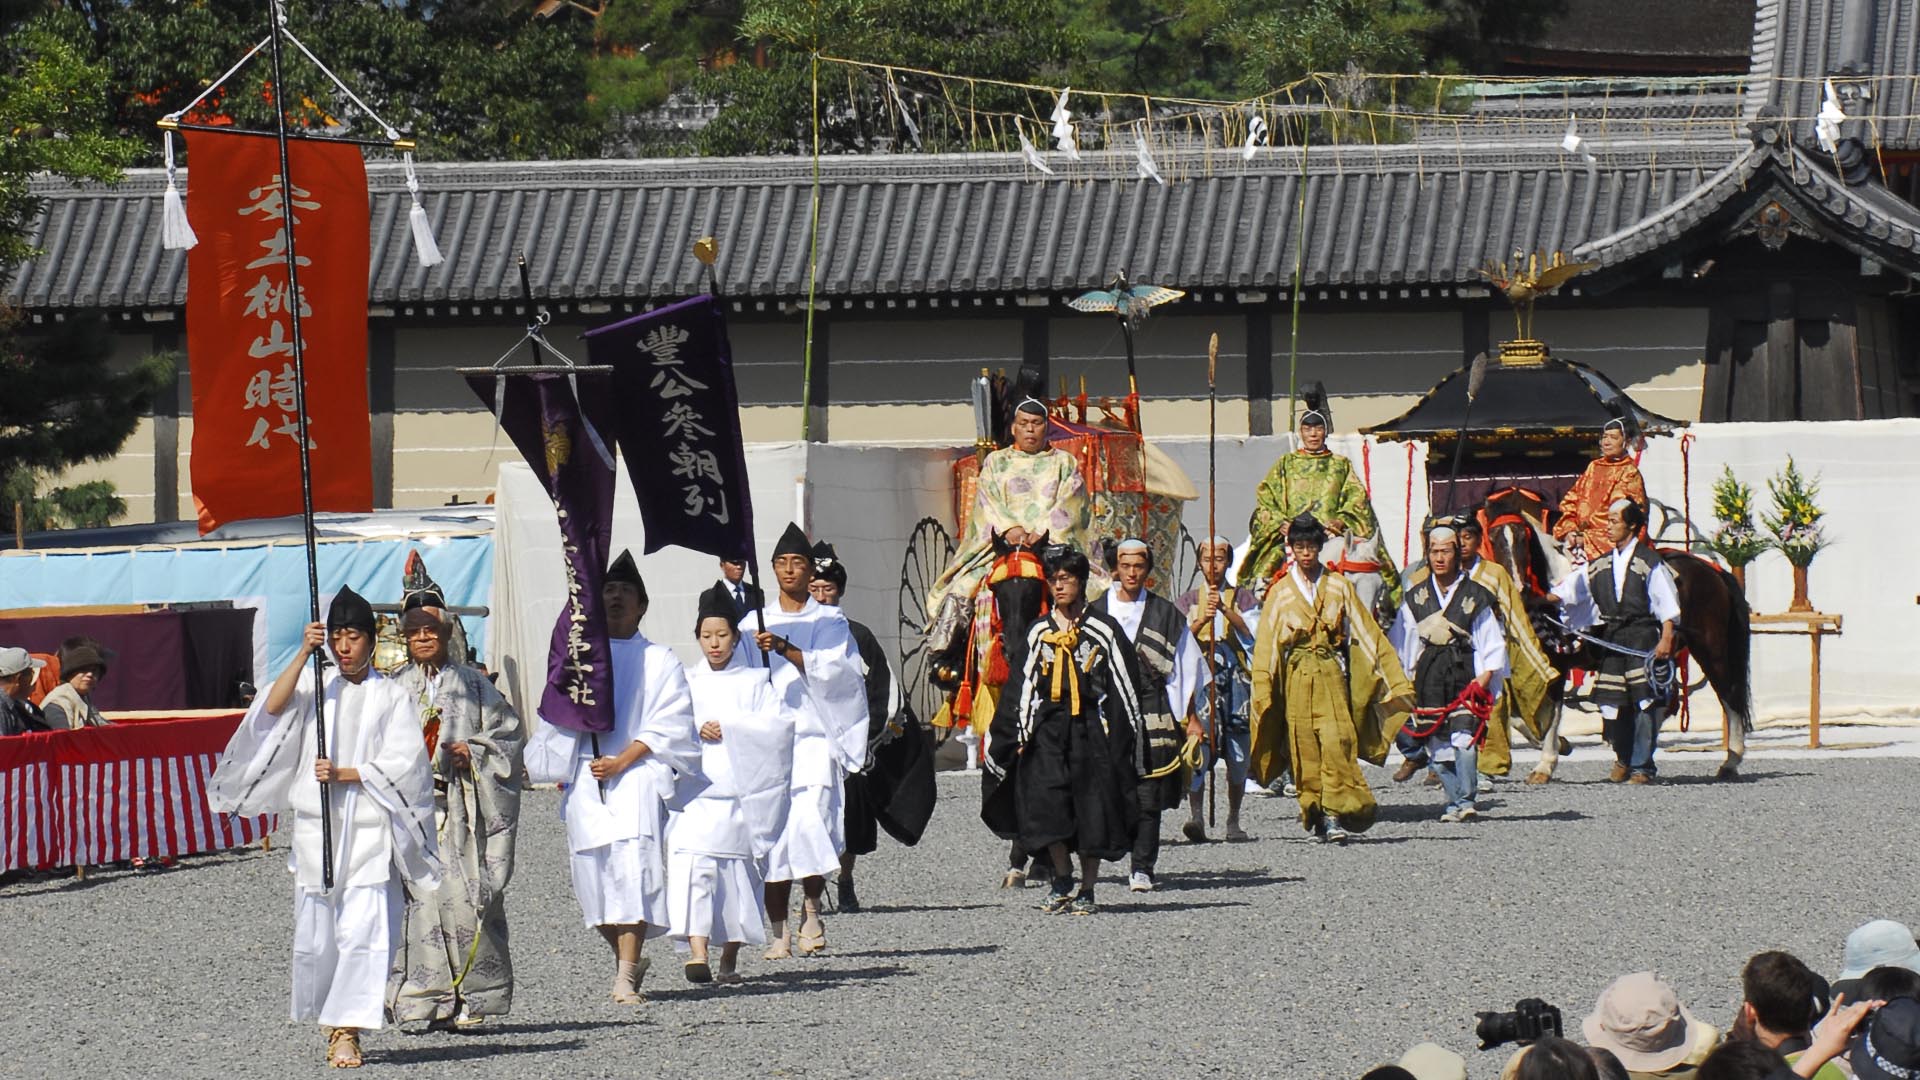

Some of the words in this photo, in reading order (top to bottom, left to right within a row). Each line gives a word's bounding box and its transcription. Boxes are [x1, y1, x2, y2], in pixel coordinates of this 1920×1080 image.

[237, 174, 322, 451] 安土桃山時代
